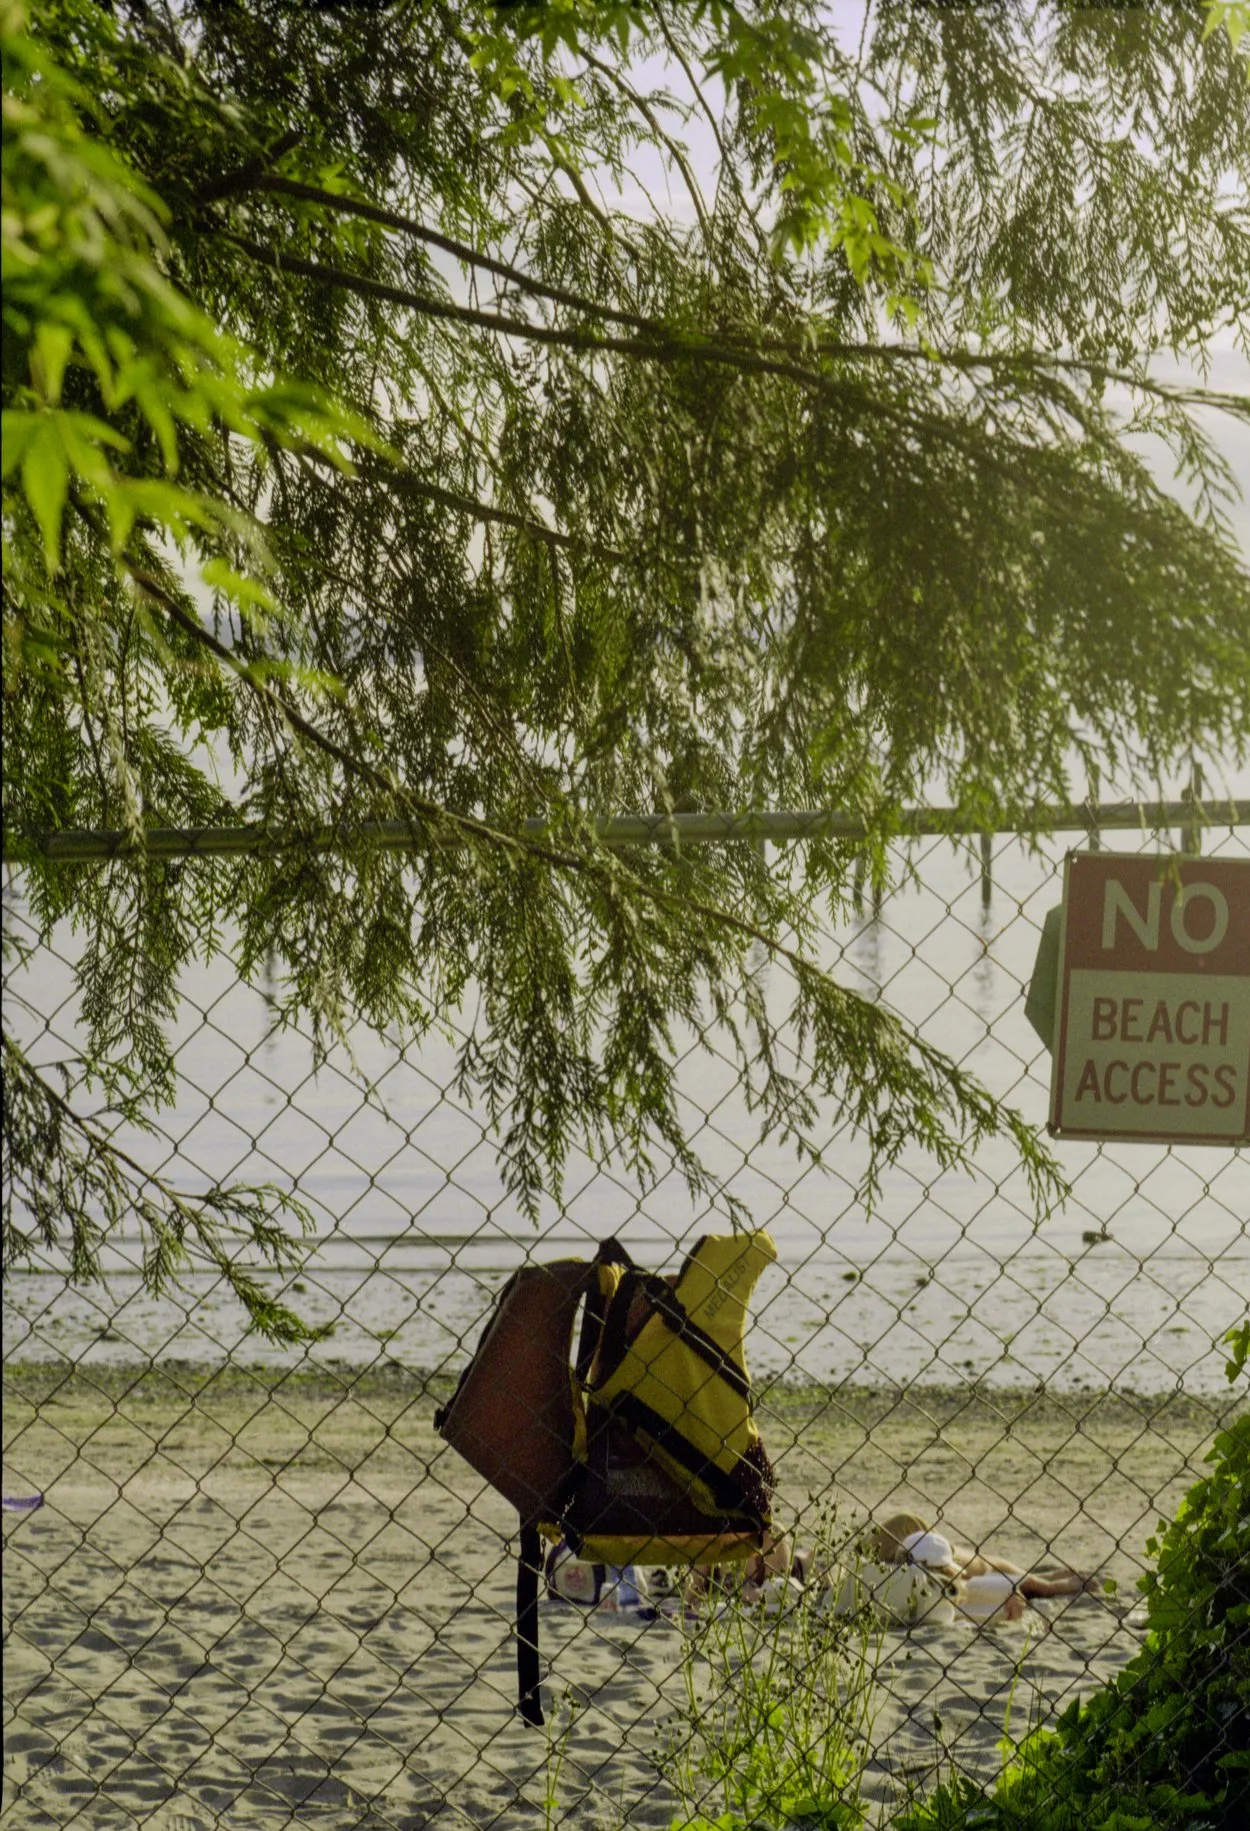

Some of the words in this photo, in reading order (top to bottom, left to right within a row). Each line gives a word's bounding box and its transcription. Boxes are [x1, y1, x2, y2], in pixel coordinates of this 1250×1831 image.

[1102, 879, 1229, 954] NO
[1092, 997, 1229, 1045] BEACH
[1075, 1059, 1237, 1108] ACCESS
